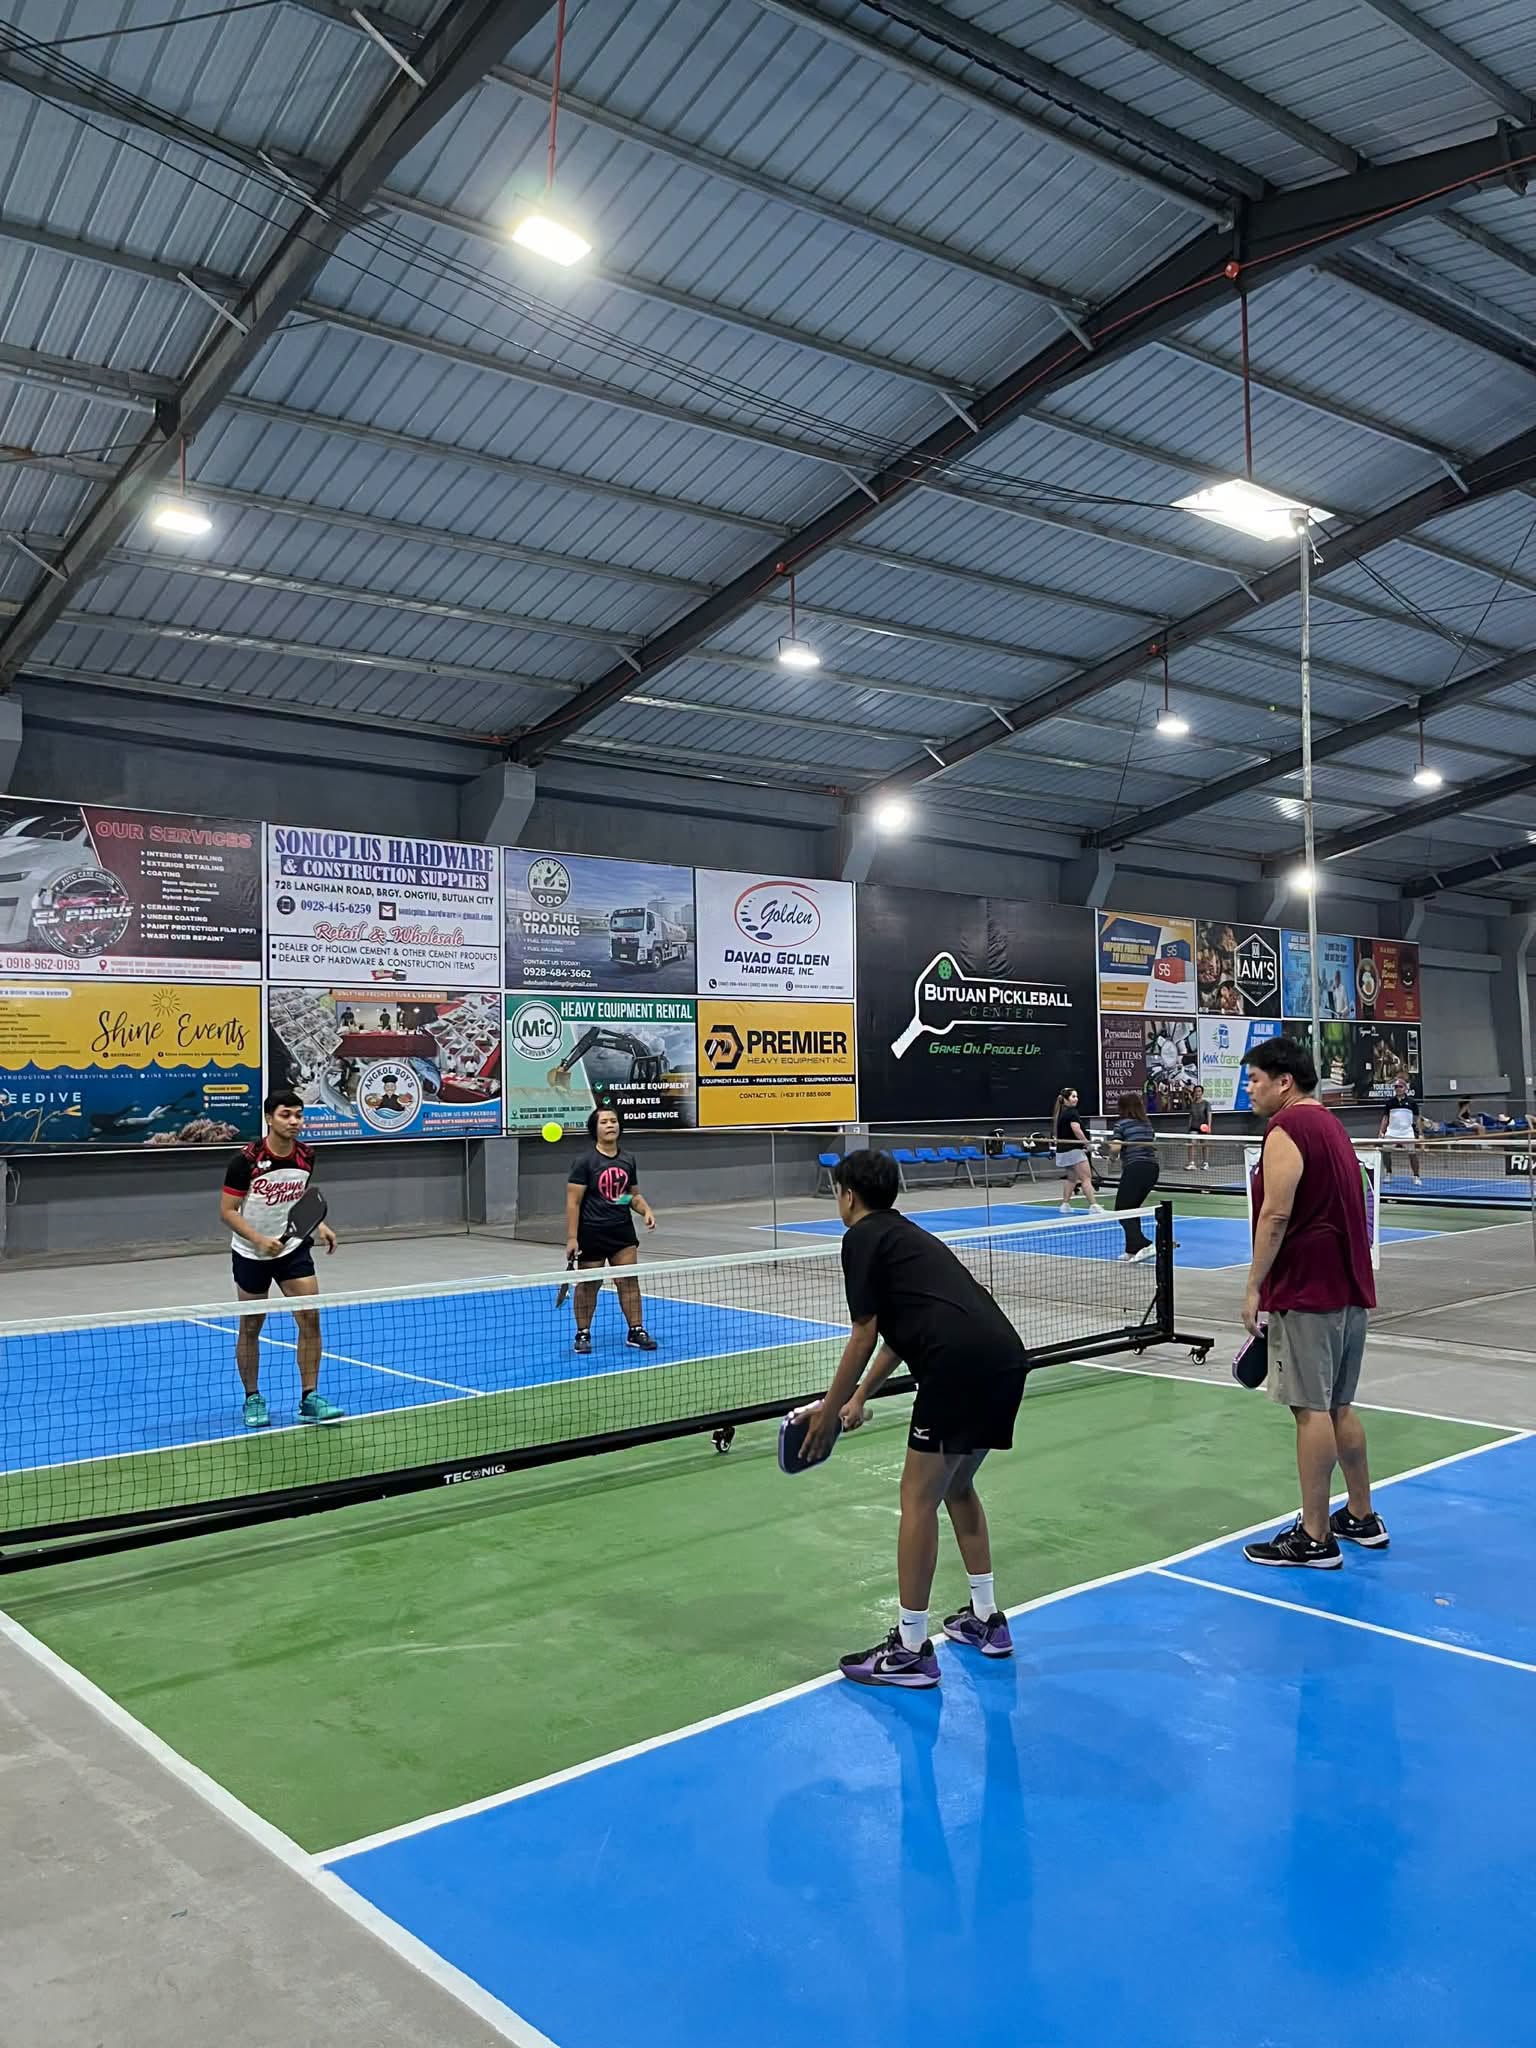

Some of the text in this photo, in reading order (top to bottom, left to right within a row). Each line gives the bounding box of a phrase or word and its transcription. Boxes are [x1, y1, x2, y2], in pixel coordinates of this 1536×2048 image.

[96, 821, 253, 849] OUR SERVICES
[147, 851, 222, 862] INTERIOR DETAILING
[275, 828, 494, 872] SONICPLUS HARDWARE
[147, 861, 224, 871] EXTERIOR DETAILING
[283, 858, 487, 890] & CONSTRUCTION SUPPLIES
[275, 880, 494, 905] 728 LANGIHAN ROAD, BRGY. ONGYIU, BUTUAN CITY
[538, 894, 562, 904] ODO
[301, 900, 371, 914] 0928-445-6259
[523, 911, 580, 925] ODO FUEL
[760, 900, 813, 930] Golden
[238, 927, 257, 935] (PPF)
[314, 921, 464, 946] Retail & Wholesale
[523, 923, 580, 936] TRADING
[279, 943, 497, 960] DEALER OF HOLCIM CEMENT & OTHER CEMENT PRODUCTS
[724, 950, 830, 966] DAVAO GOLDEN
[6, 957, 80, 970] 0918-962-0193
[279, 954, 475, 970] DEALER OF HARDWARE & CONSTRUCTION ITEMS
[523, 967, 592, 978] 0928-484-3662
[741, 965, 815, 976] HARDWARE, INC.
[1237, 959, 1275, 981] IAM'S
[924, 983, 1073, 1007] BUTUAN PICKLEBALL
[560, 1001, 693, 1019] HEAVY EQUIPMENT RENTAL
[969, 1006, 1034, 1019] CENTER
[91, 1010, 250, 1052] Shine Events
[747, 1030, 847, 1054] PREMIER
[929, 1042, 1041, 1055] GAME ON. PADDLE UP.
[1104, 1051, 1142, 1060] GIFT ITEMS
[1105, 1060, 1135, 1068] T-SHIRTS
[365, 1067, 414, 1090] ANGKOL BOY'S
[1105, 1068, 1132, 1077] TOKENS
[1105, 1077, 1124, 1085] BAGS
[8, 1092, 82, 1103] EEDIVE
